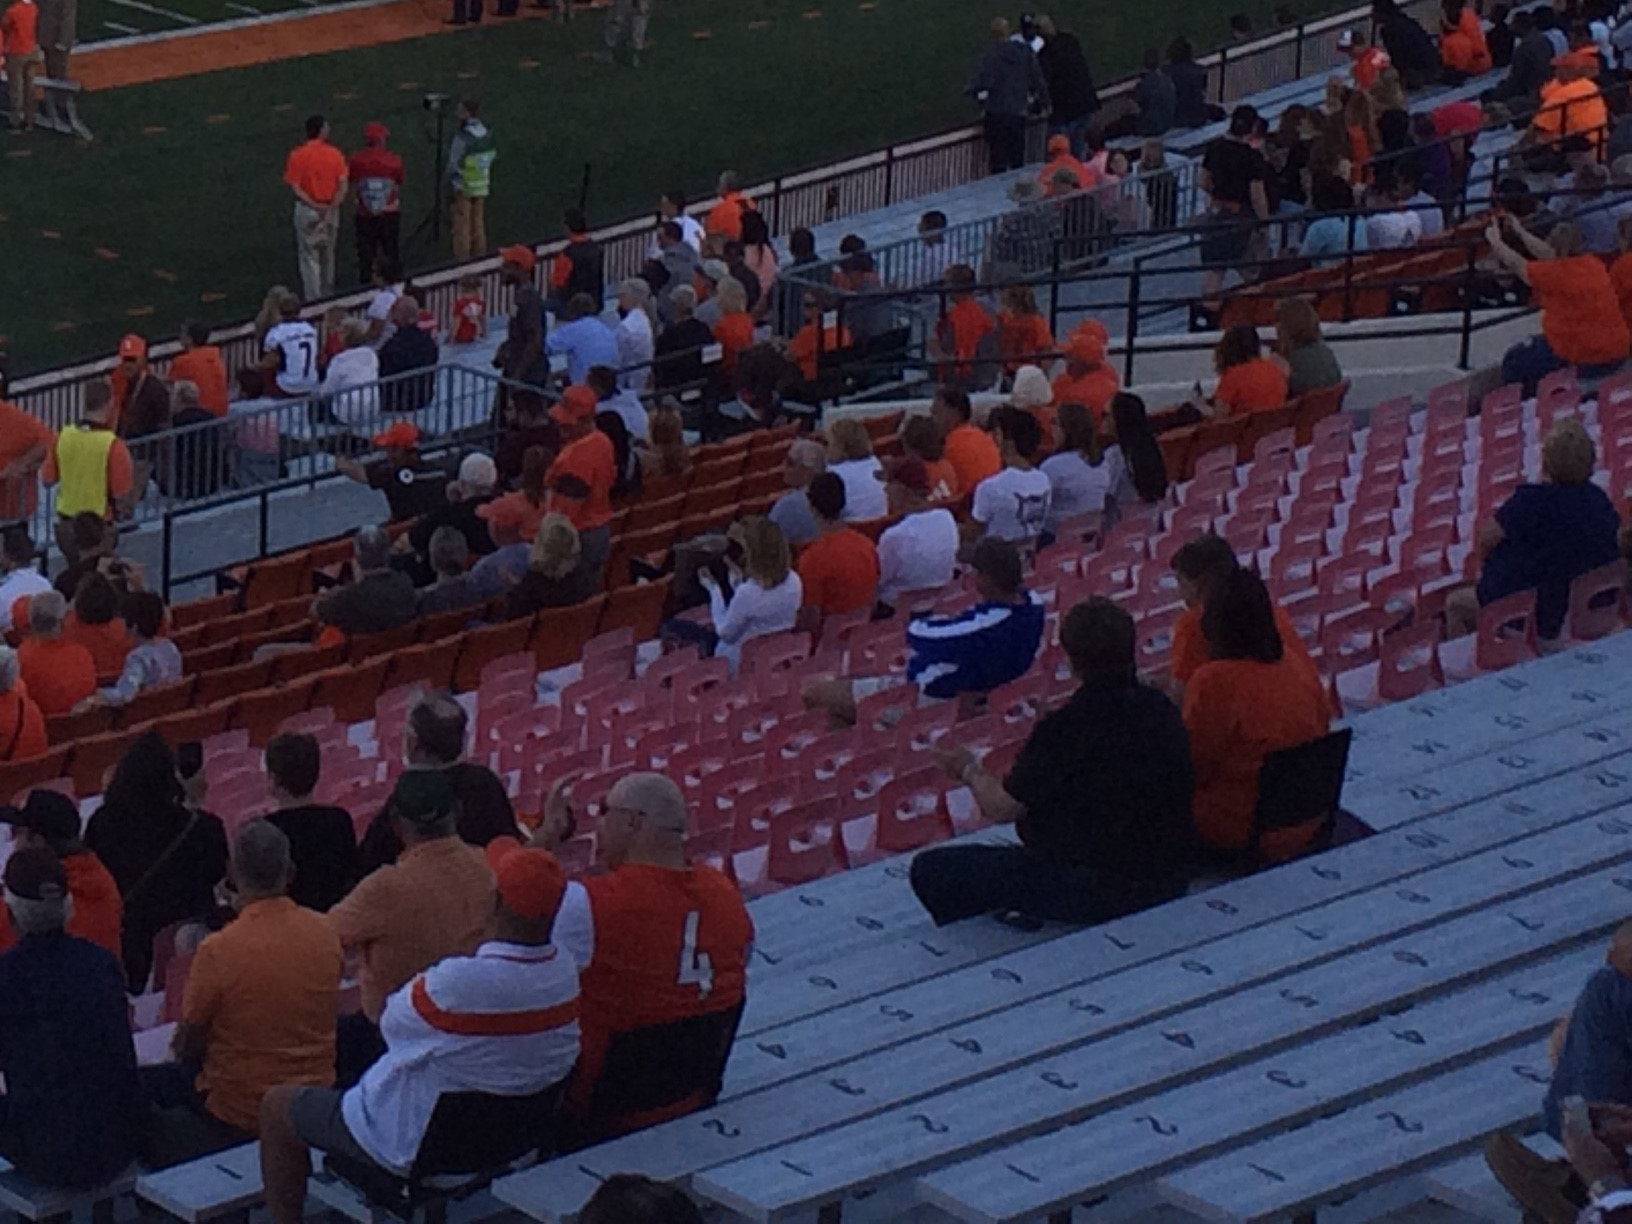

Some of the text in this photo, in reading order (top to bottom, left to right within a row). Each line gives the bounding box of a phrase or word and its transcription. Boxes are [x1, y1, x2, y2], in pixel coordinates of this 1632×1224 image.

[298, 341, 312, 379] 7
[1508, 913, 1544, 931] 7
[1105, 935, 1134, 949] 7
[1295, 926, 1326, 940] 7
[676, 910, 715, 1000] 4
[1160, 1032, 1195, 1049] 4
[1390, 1030, 1426, 1045] 4
[1040, 1072, 1078, 1090] 3
[1267, 1070, 1307, 1088] 3
[702, 1119, 740, 1137] 2
[907, 1115, 949, 1133] 2
[1133, 1114, 1179, 1136] 2
[1375, 1110, 1425, 1133] 2
[1006, 1164, 1040, 1182] 1
[1247, 1163, 1285, 1182] 1
